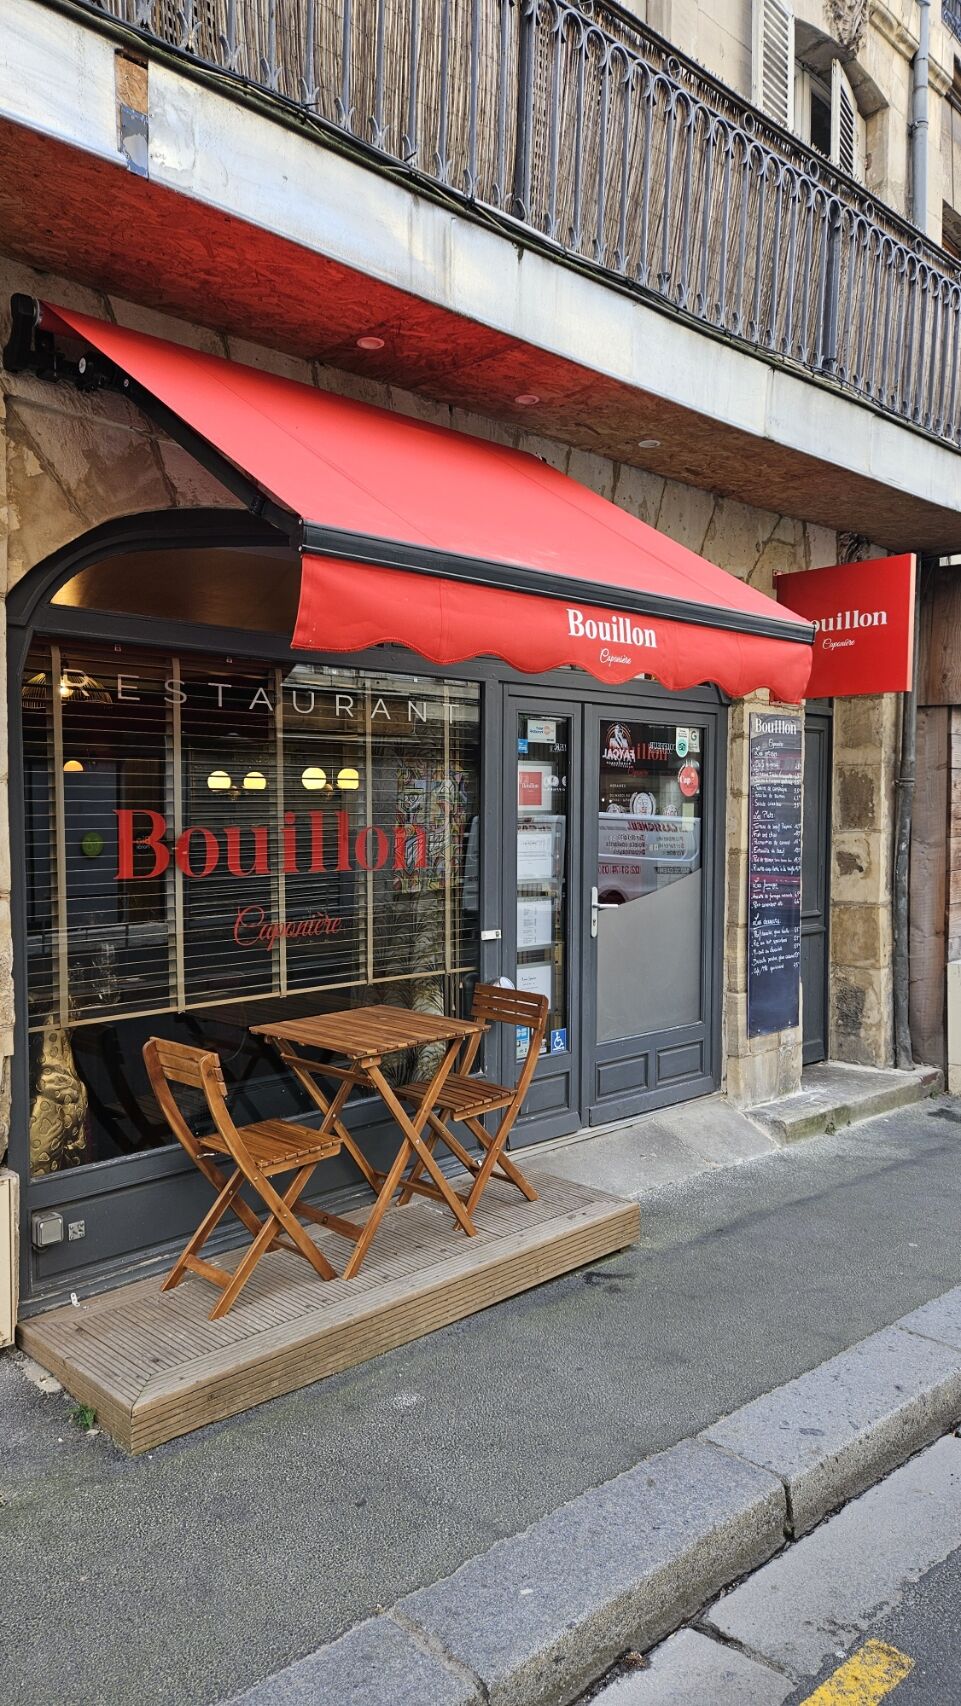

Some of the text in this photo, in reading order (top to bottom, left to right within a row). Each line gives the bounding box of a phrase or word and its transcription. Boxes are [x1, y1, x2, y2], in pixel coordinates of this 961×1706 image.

[566, 608, 658, 648] Bouillon
[811, 610, 888, 632] ouillon
[600, 648, 632, 667] Caponière
[63, 668, 459, 725] RESTAURANT
[755, 718, 797, 735] Bouillon
[113, 809, 429, 880] Bouillon
[233, 904, 342, 951] Caponière
